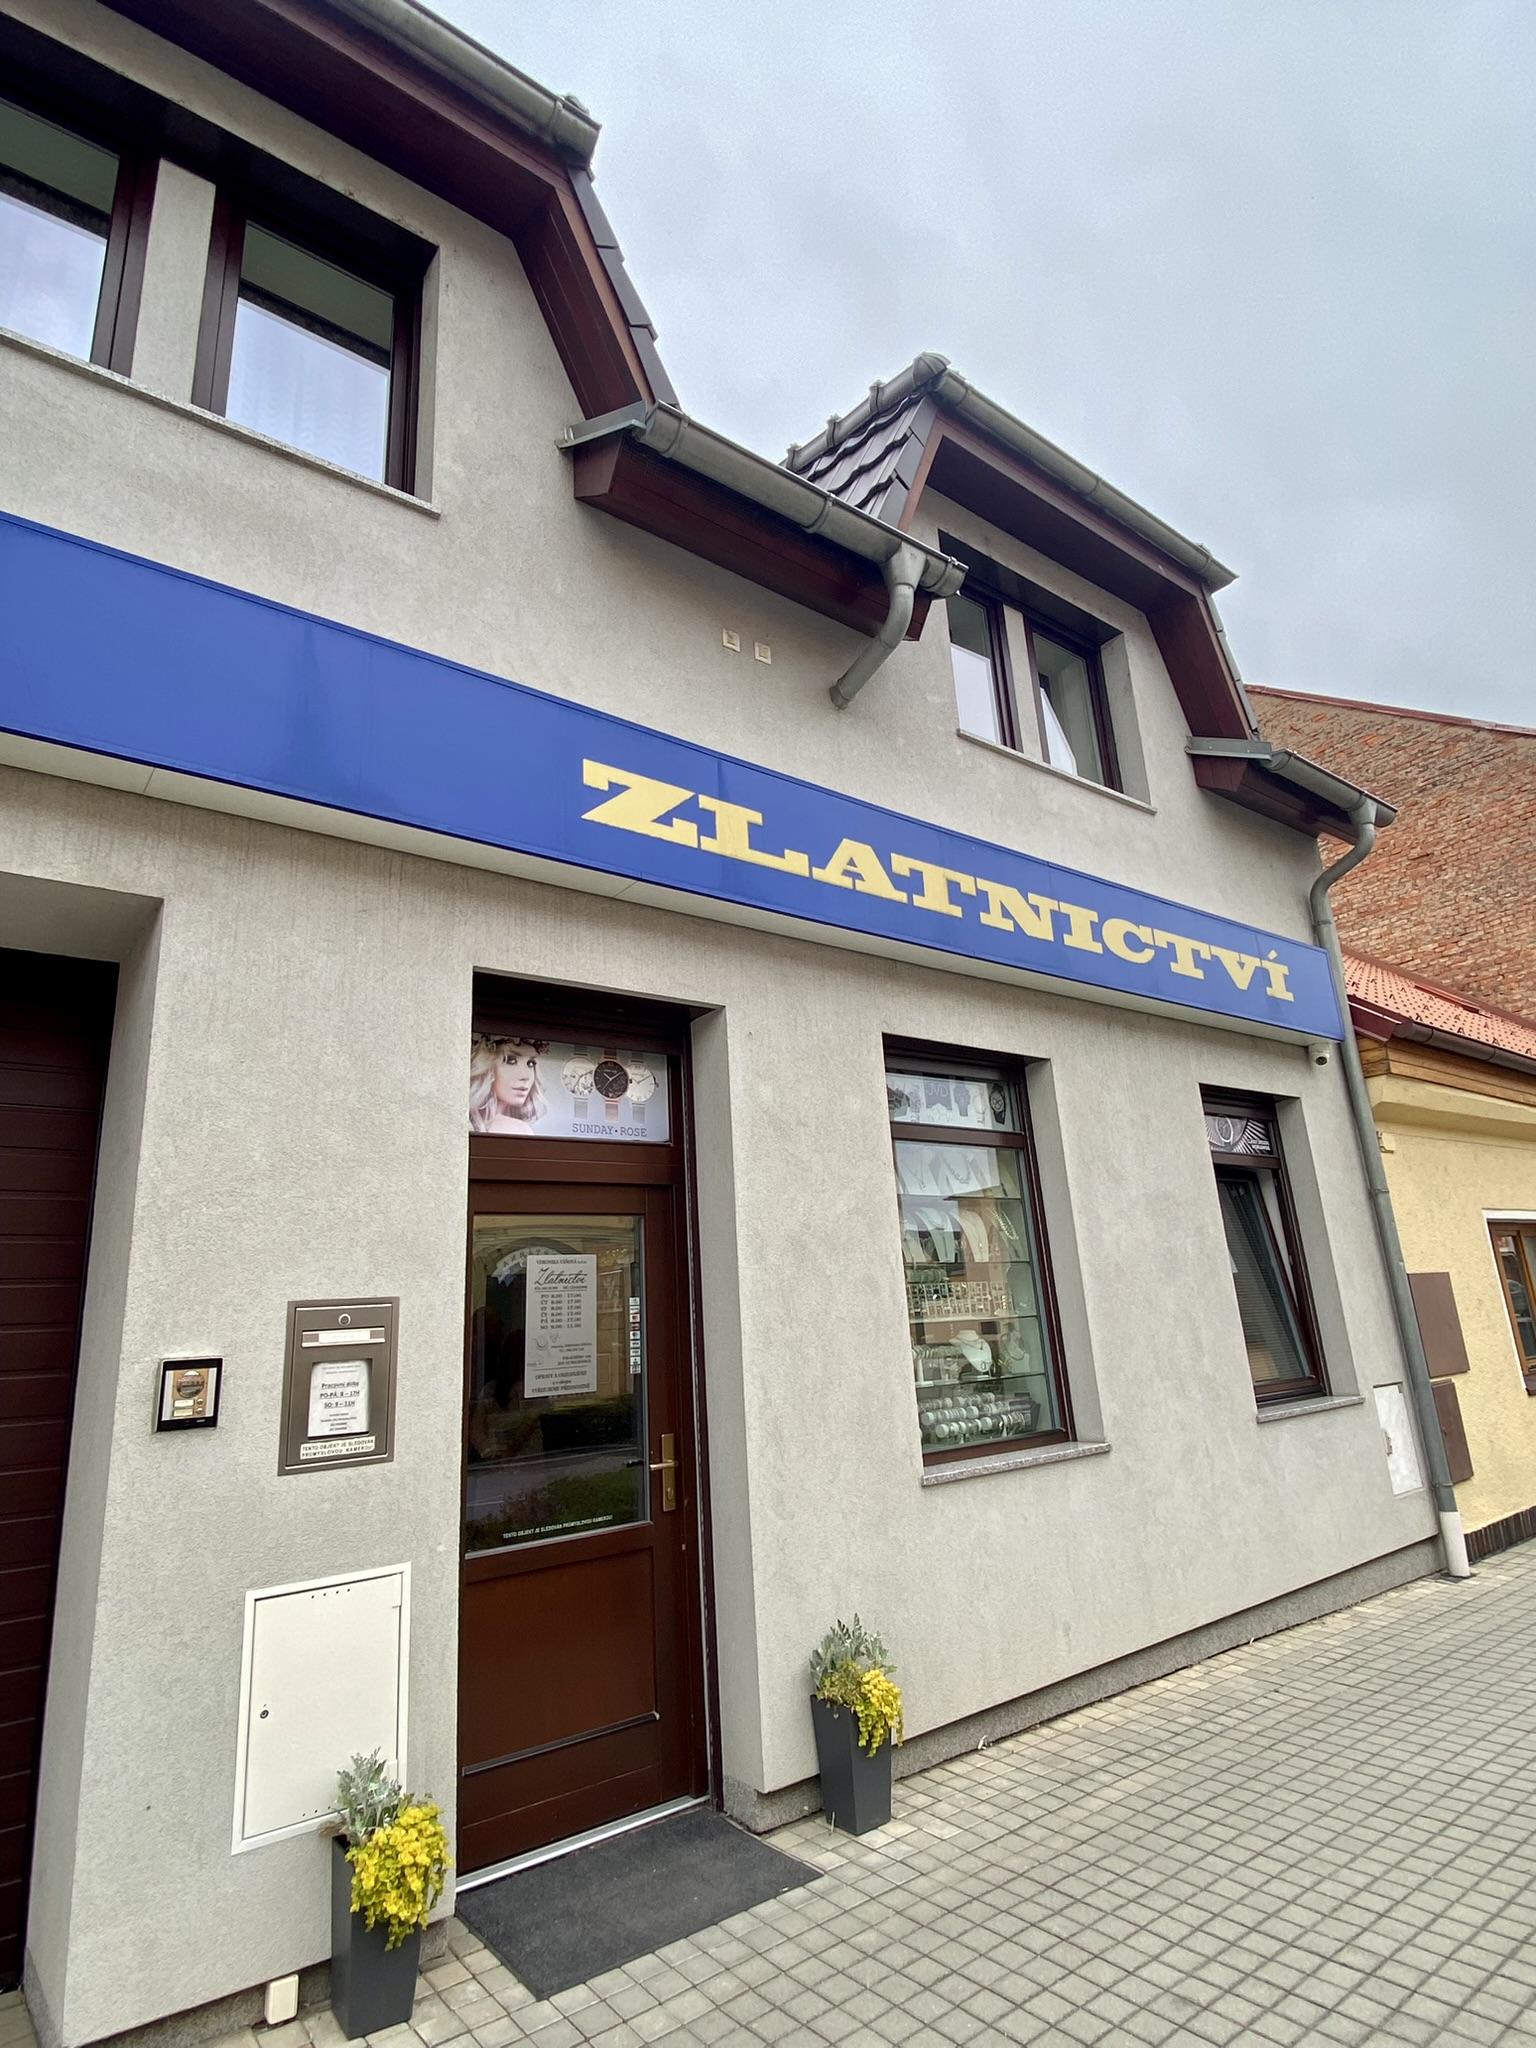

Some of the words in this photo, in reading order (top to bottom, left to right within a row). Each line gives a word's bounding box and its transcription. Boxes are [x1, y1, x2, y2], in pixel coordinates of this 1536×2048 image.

[582, 759, 1295, 1002] ZLATNICTVÍ
[928, 1083, 948, 1097] JVD
[572, 1123, 614, 1135] SUNDAY
[620, 1127, 647, 1137] ROSE
